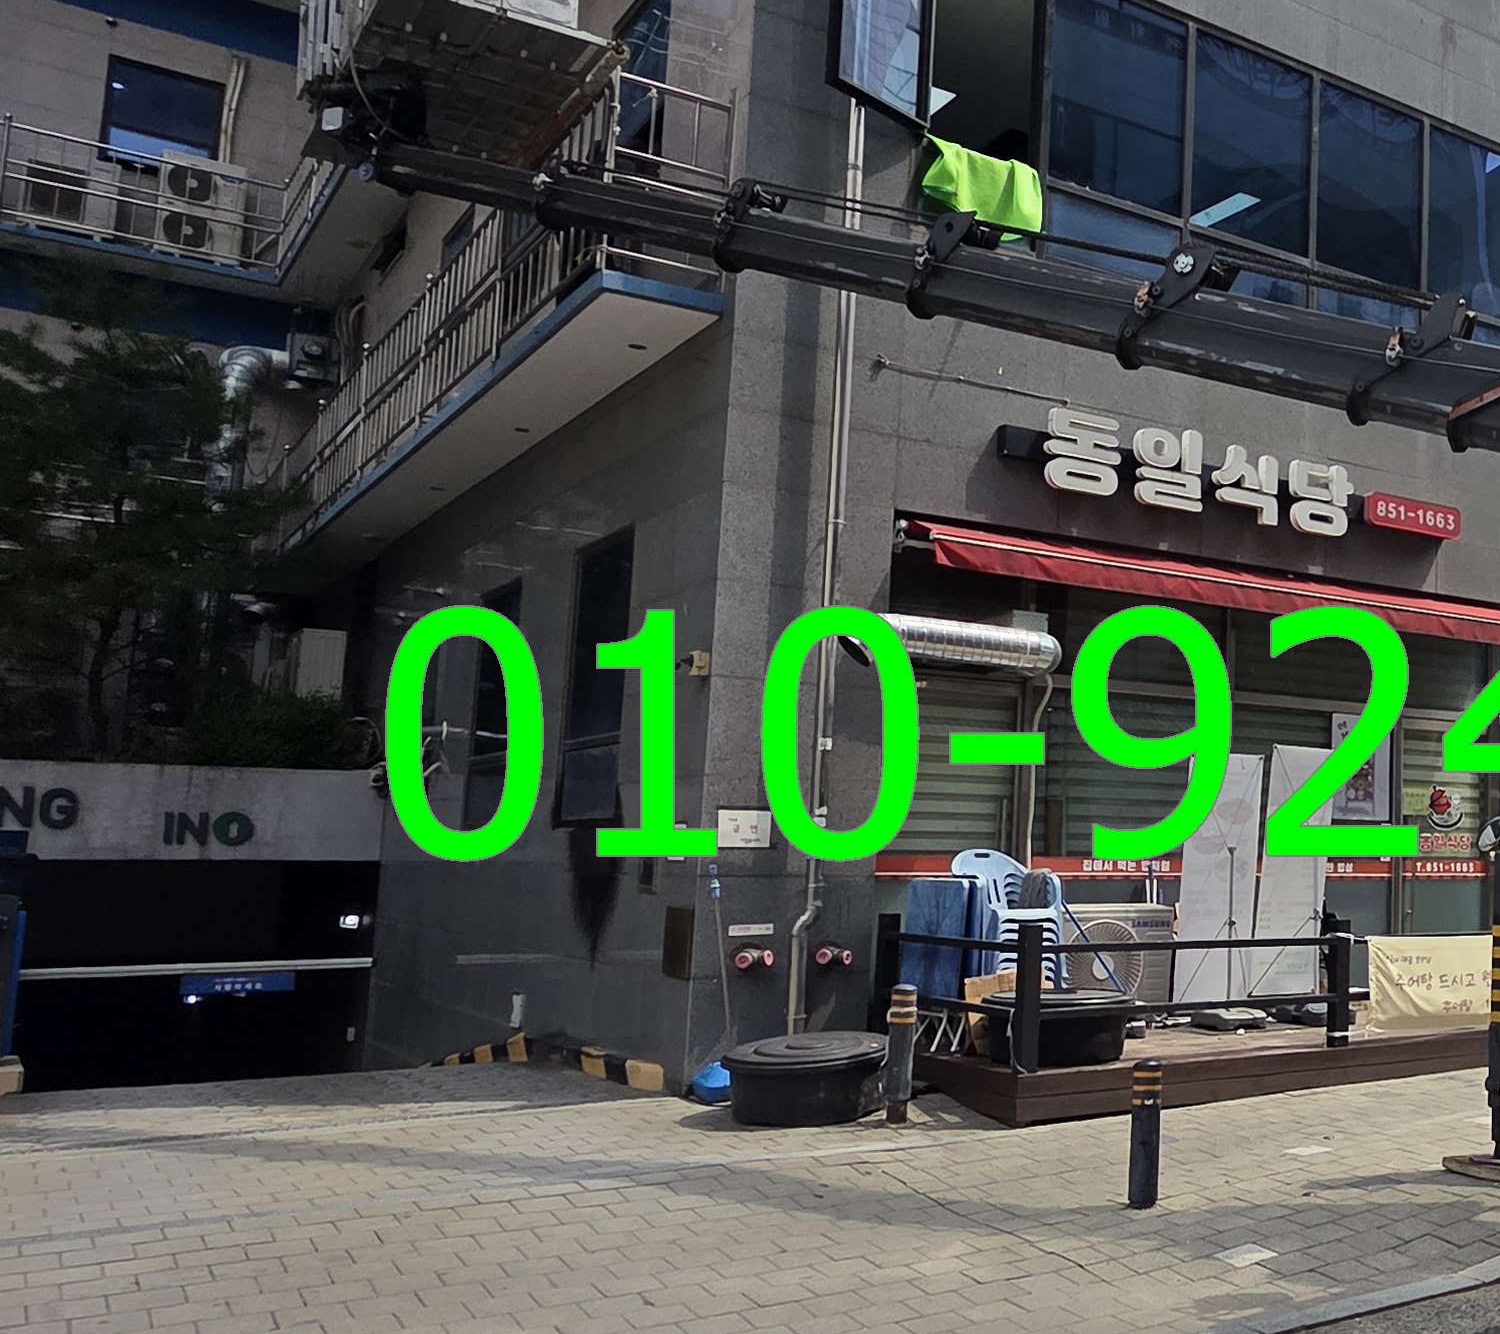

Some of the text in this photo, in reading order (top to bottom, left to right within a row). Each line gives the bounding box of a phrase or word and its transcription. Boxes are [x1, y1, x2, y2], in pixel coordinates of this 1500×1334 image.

[1043, 405, 1456, 537] 동일식당 851-1663
[1419, 832, 1472, 852] 동일식당
[1131, 919, 1172, 929] SAMSUNG
[1394, 972, 1434, 991] 추어탕
[1438, 972, 1477, 989] 드시고
